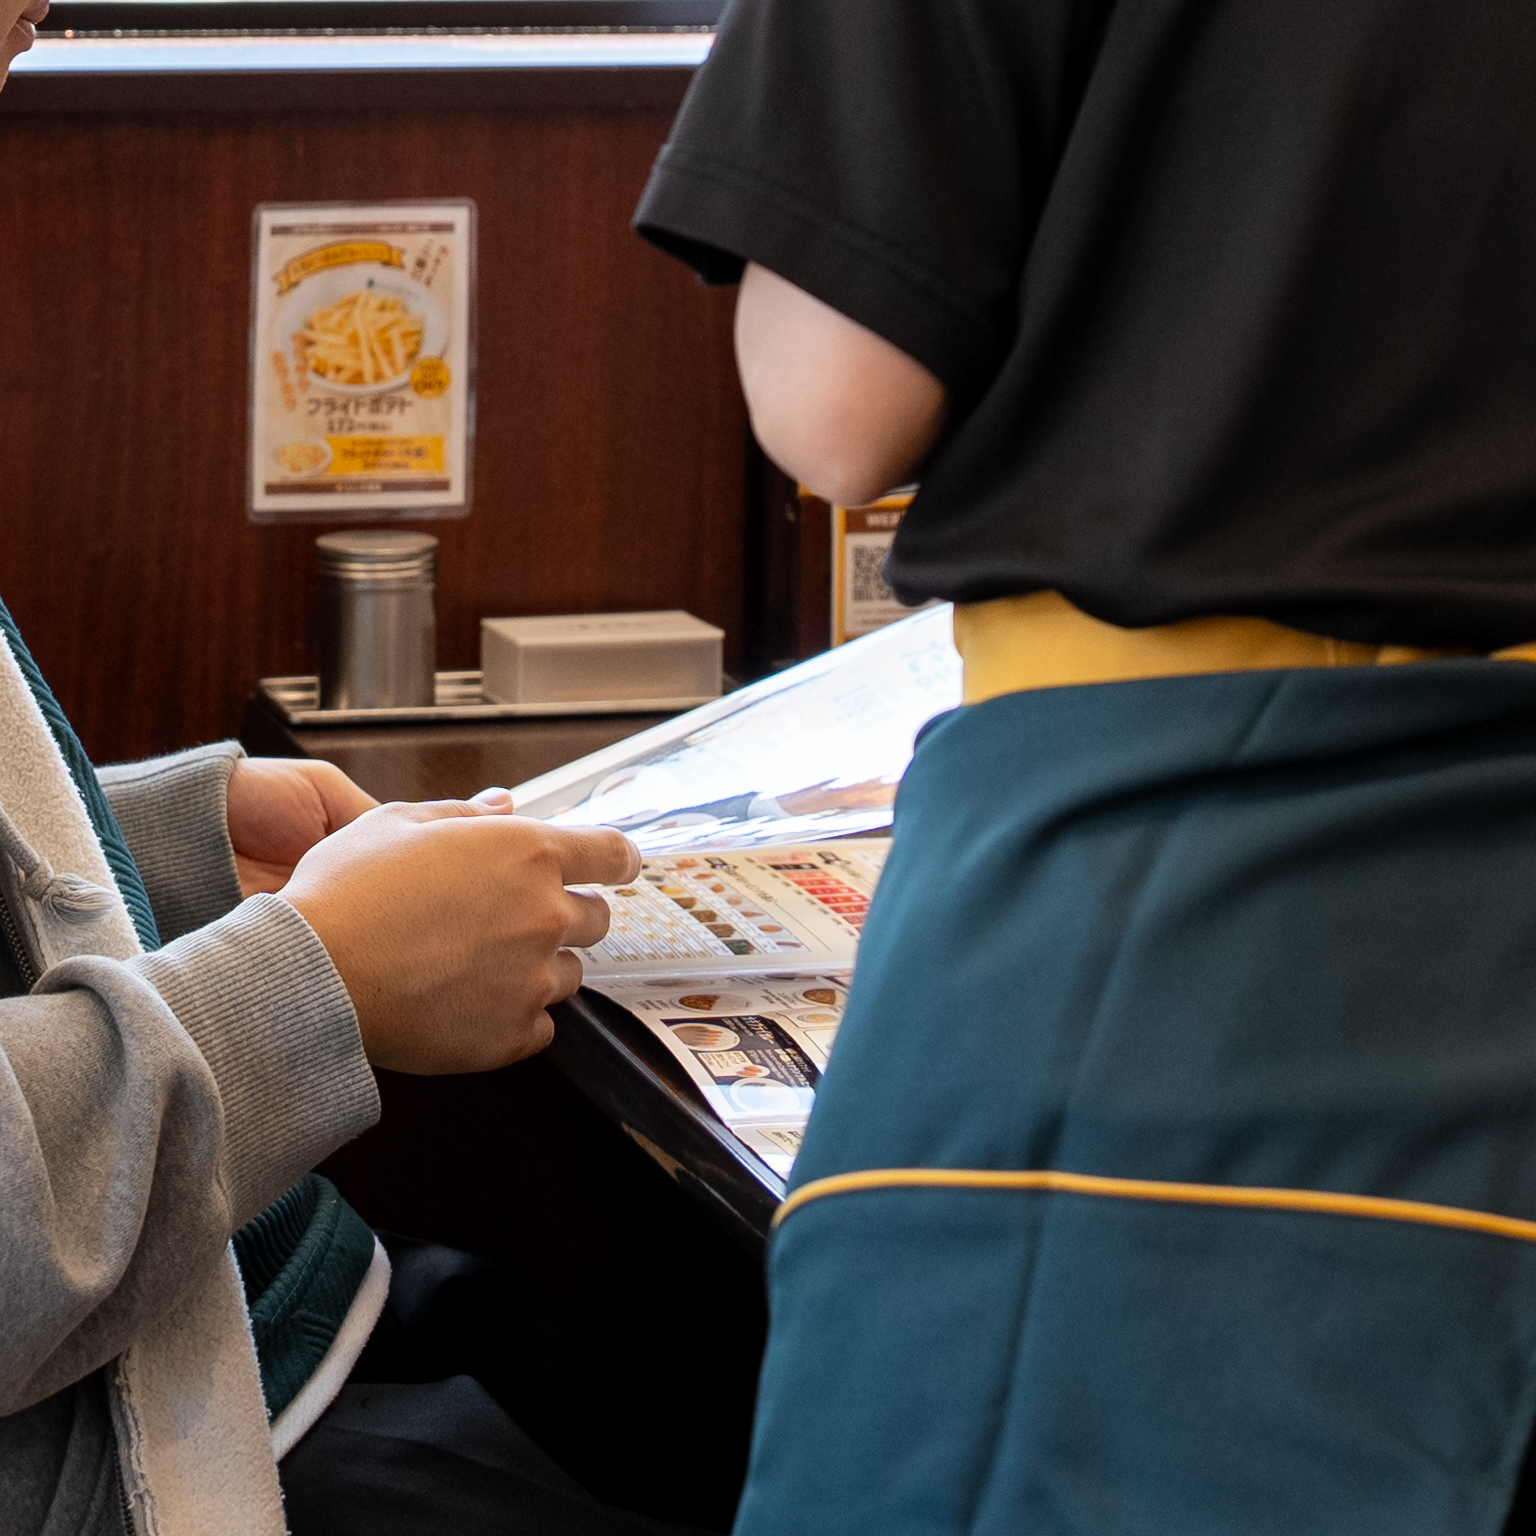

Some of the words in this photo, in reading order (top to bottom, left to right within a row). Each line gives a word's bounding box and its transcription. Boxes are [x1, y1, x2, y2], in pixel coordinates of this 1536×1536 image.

[307, 394, 414, 416] フライドポテト
